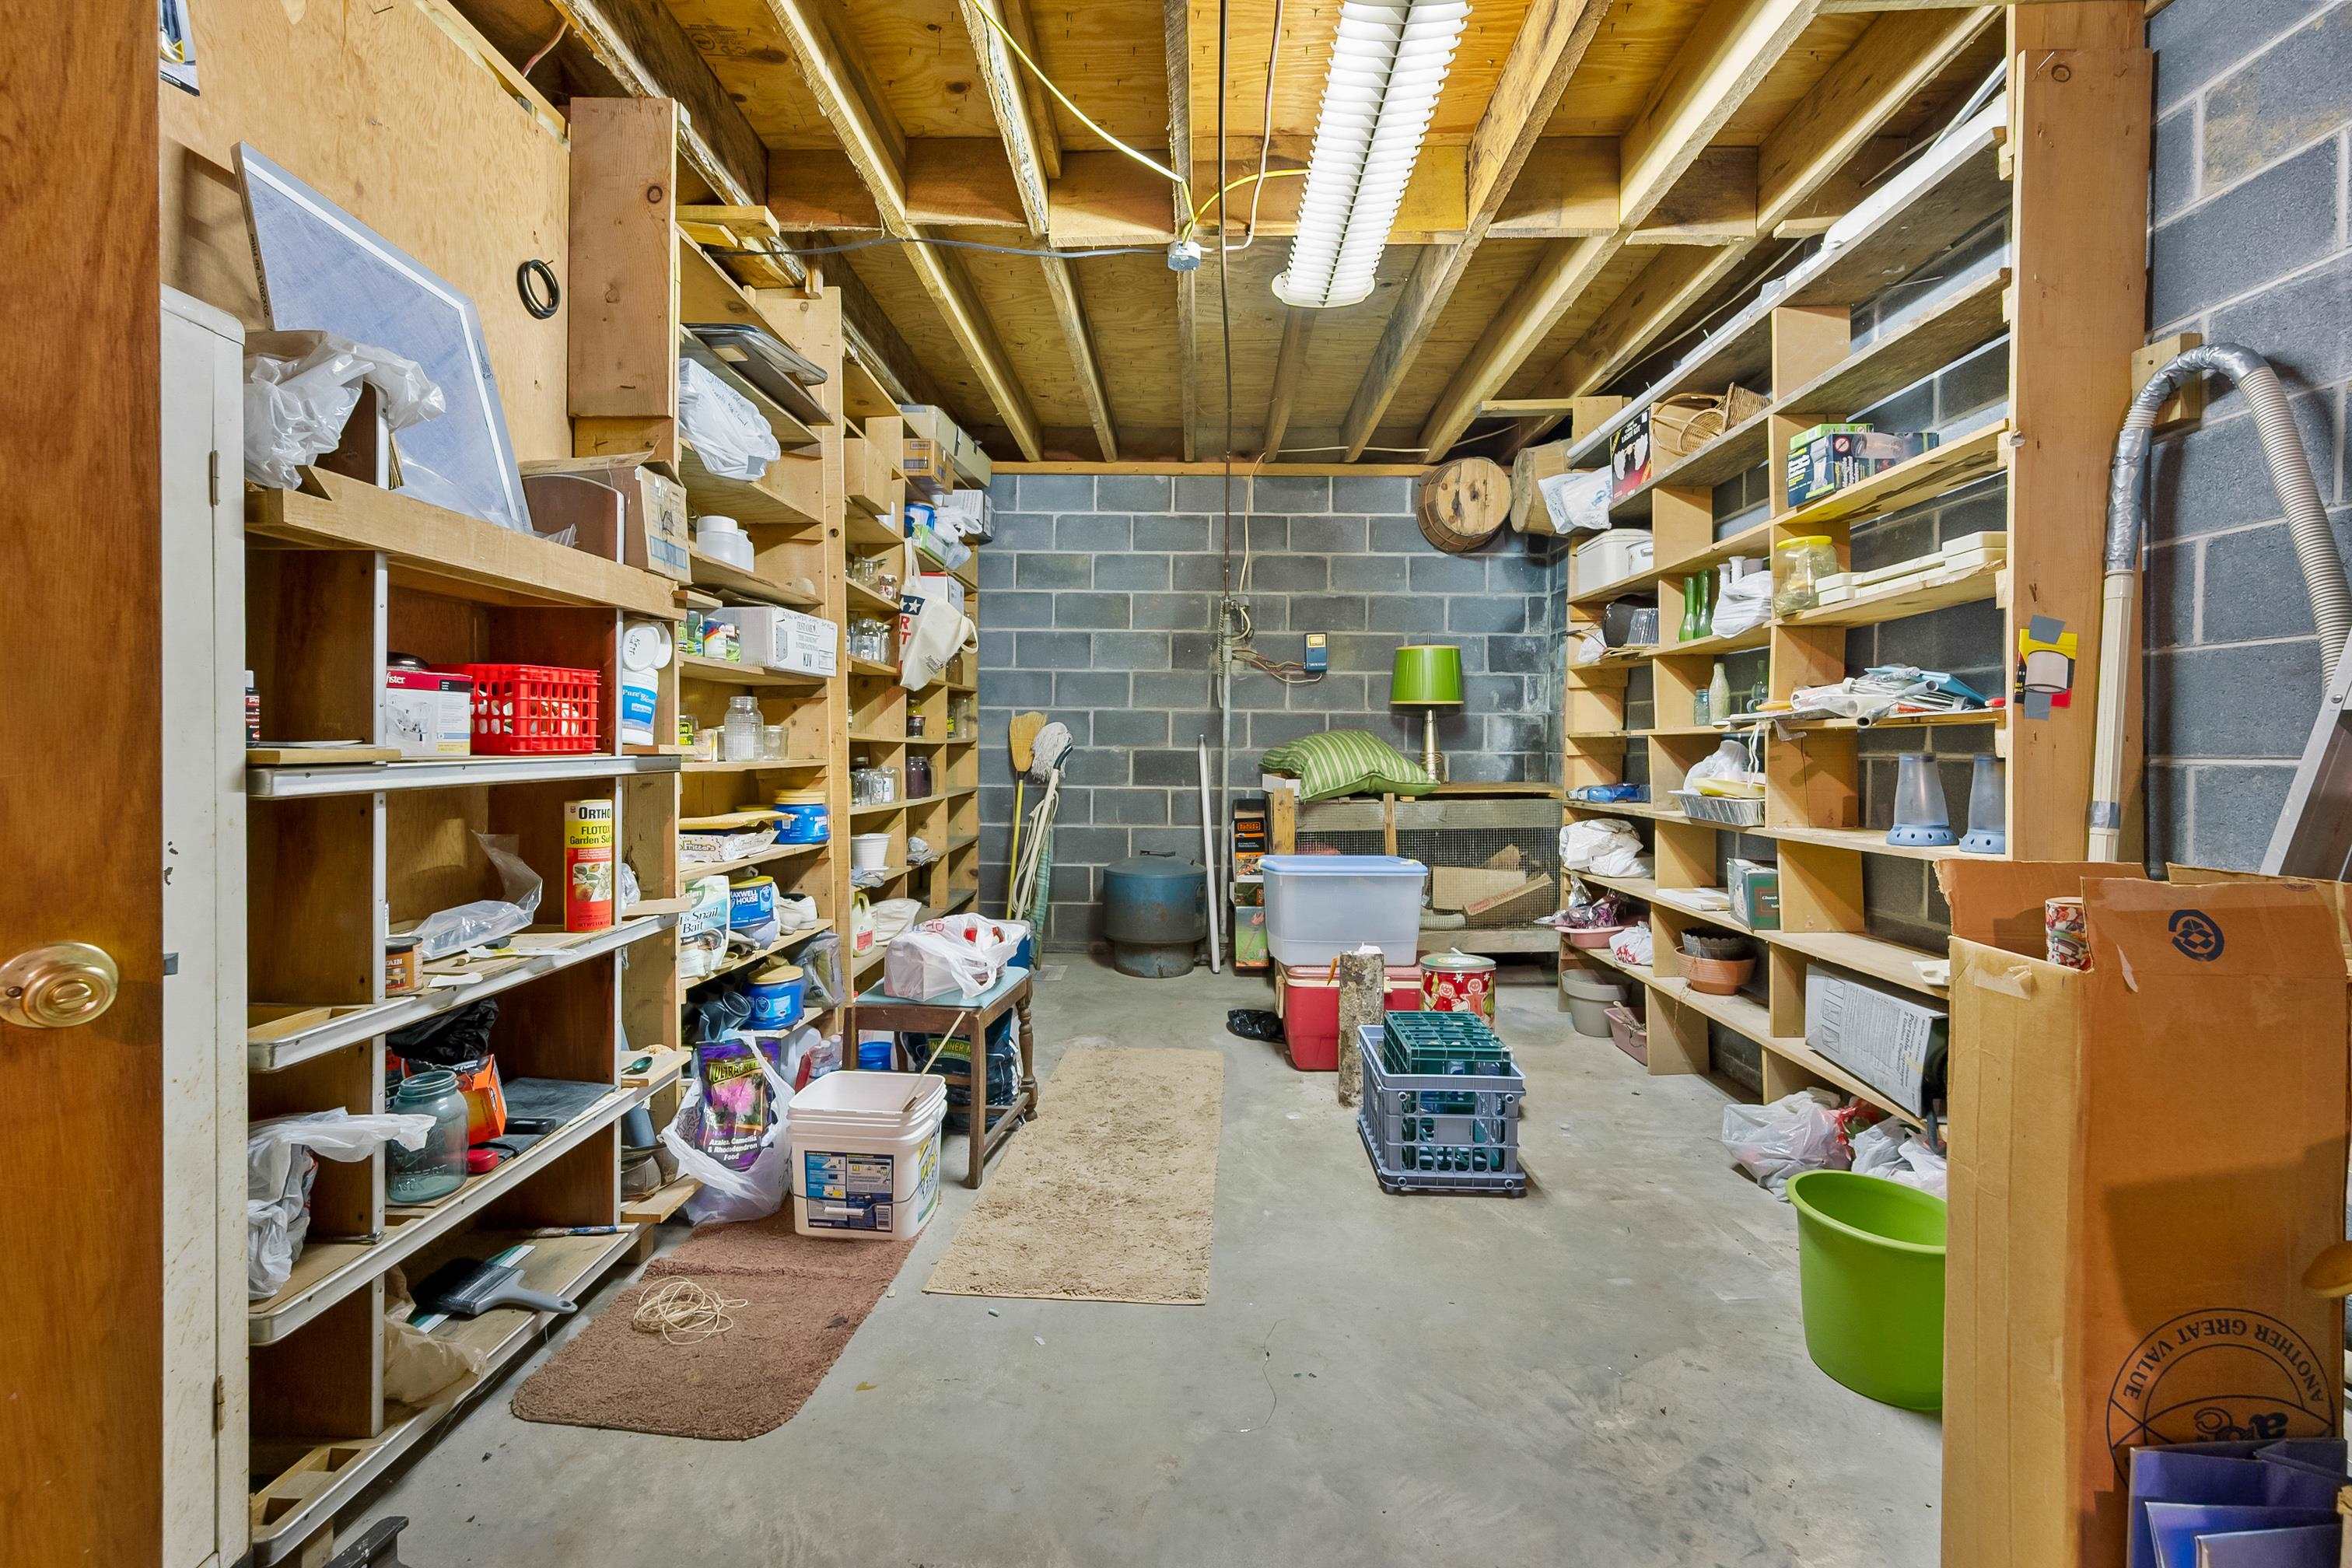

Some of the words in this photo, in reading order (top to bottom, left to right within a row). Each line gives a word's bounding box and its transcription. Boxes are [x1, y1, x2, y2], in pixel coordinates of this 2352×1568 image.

[803, 653, 812, 668] KJV
[579, 807, 611, 819] ORTHO
[570, 835, 599, 845] Garden
[736, 895, 758, 905] HOUSE
[692, 907, 718, 920] Snail
[683, 922, 703, 933] Bait
[2176, 1318, 2248, 1346] GREAT
[2123, 1339, 2174, 1400] VALUE
[2255, 1324, 2324, 1402] ANOTHER
